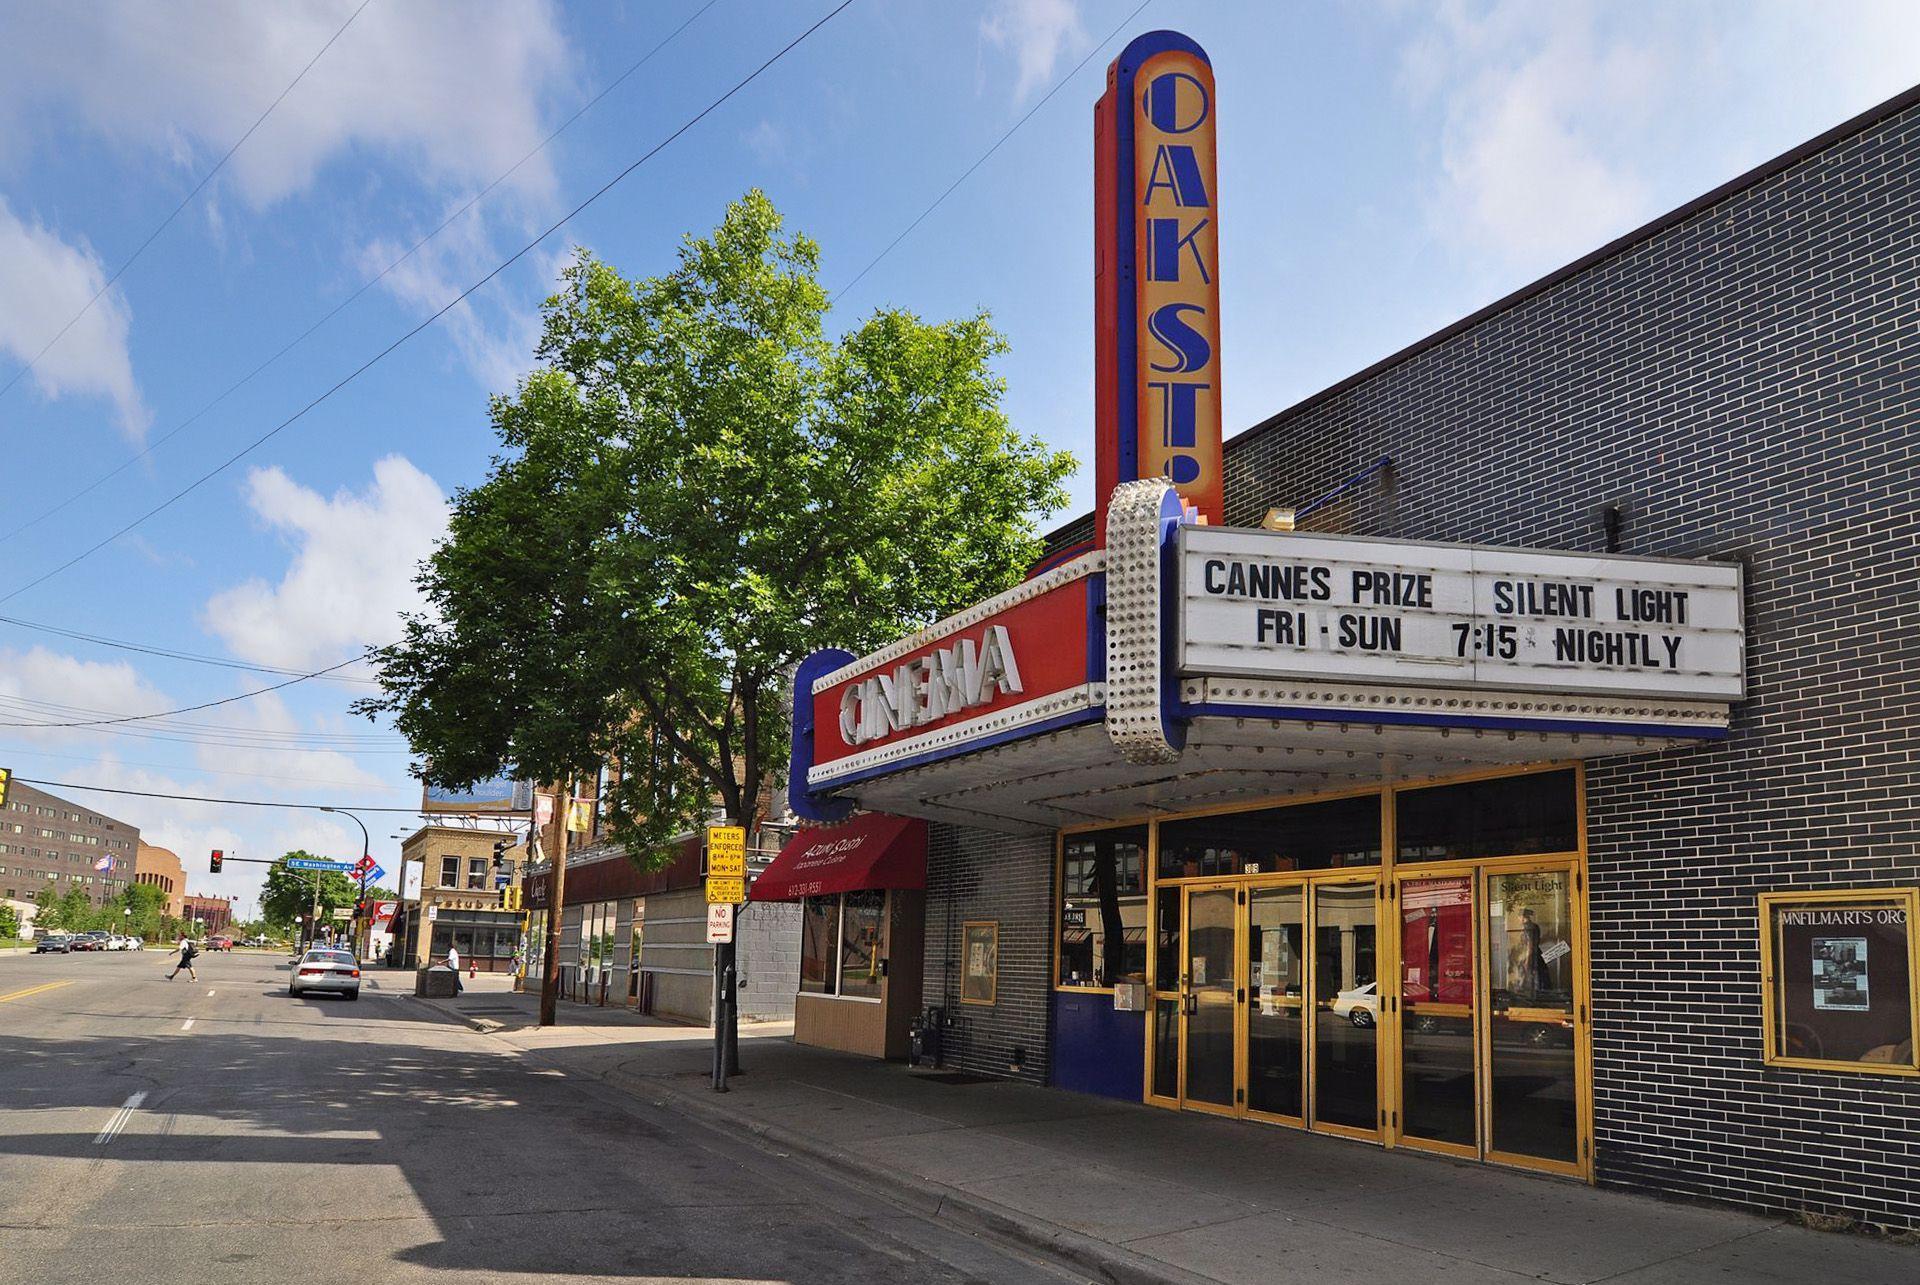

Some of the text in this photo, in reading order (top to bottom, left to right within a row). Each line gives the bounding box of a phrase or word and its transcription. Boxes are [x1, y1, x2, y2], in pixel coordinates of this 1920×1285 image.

[1205, 559, 1688, 624] CANNES PRIZE SILENT LIGHT
[1257, 608, 1306, 647] FRI
[1339, 613, 1401, 652] SUN
[1452, 622, 1517, 659] 7:15
[1556, 627, 1682, 669] NIGHTLY
[839, 625, 1023, 745] CINEMA
[713, 832, 740, 841] METERS
[710, 843, 744, 851] ENFORCED
[303, 861, 341, 869] Washington
[1501, 879, 1563, 892] Silent Light
[715, 909, 726, 919] NO
